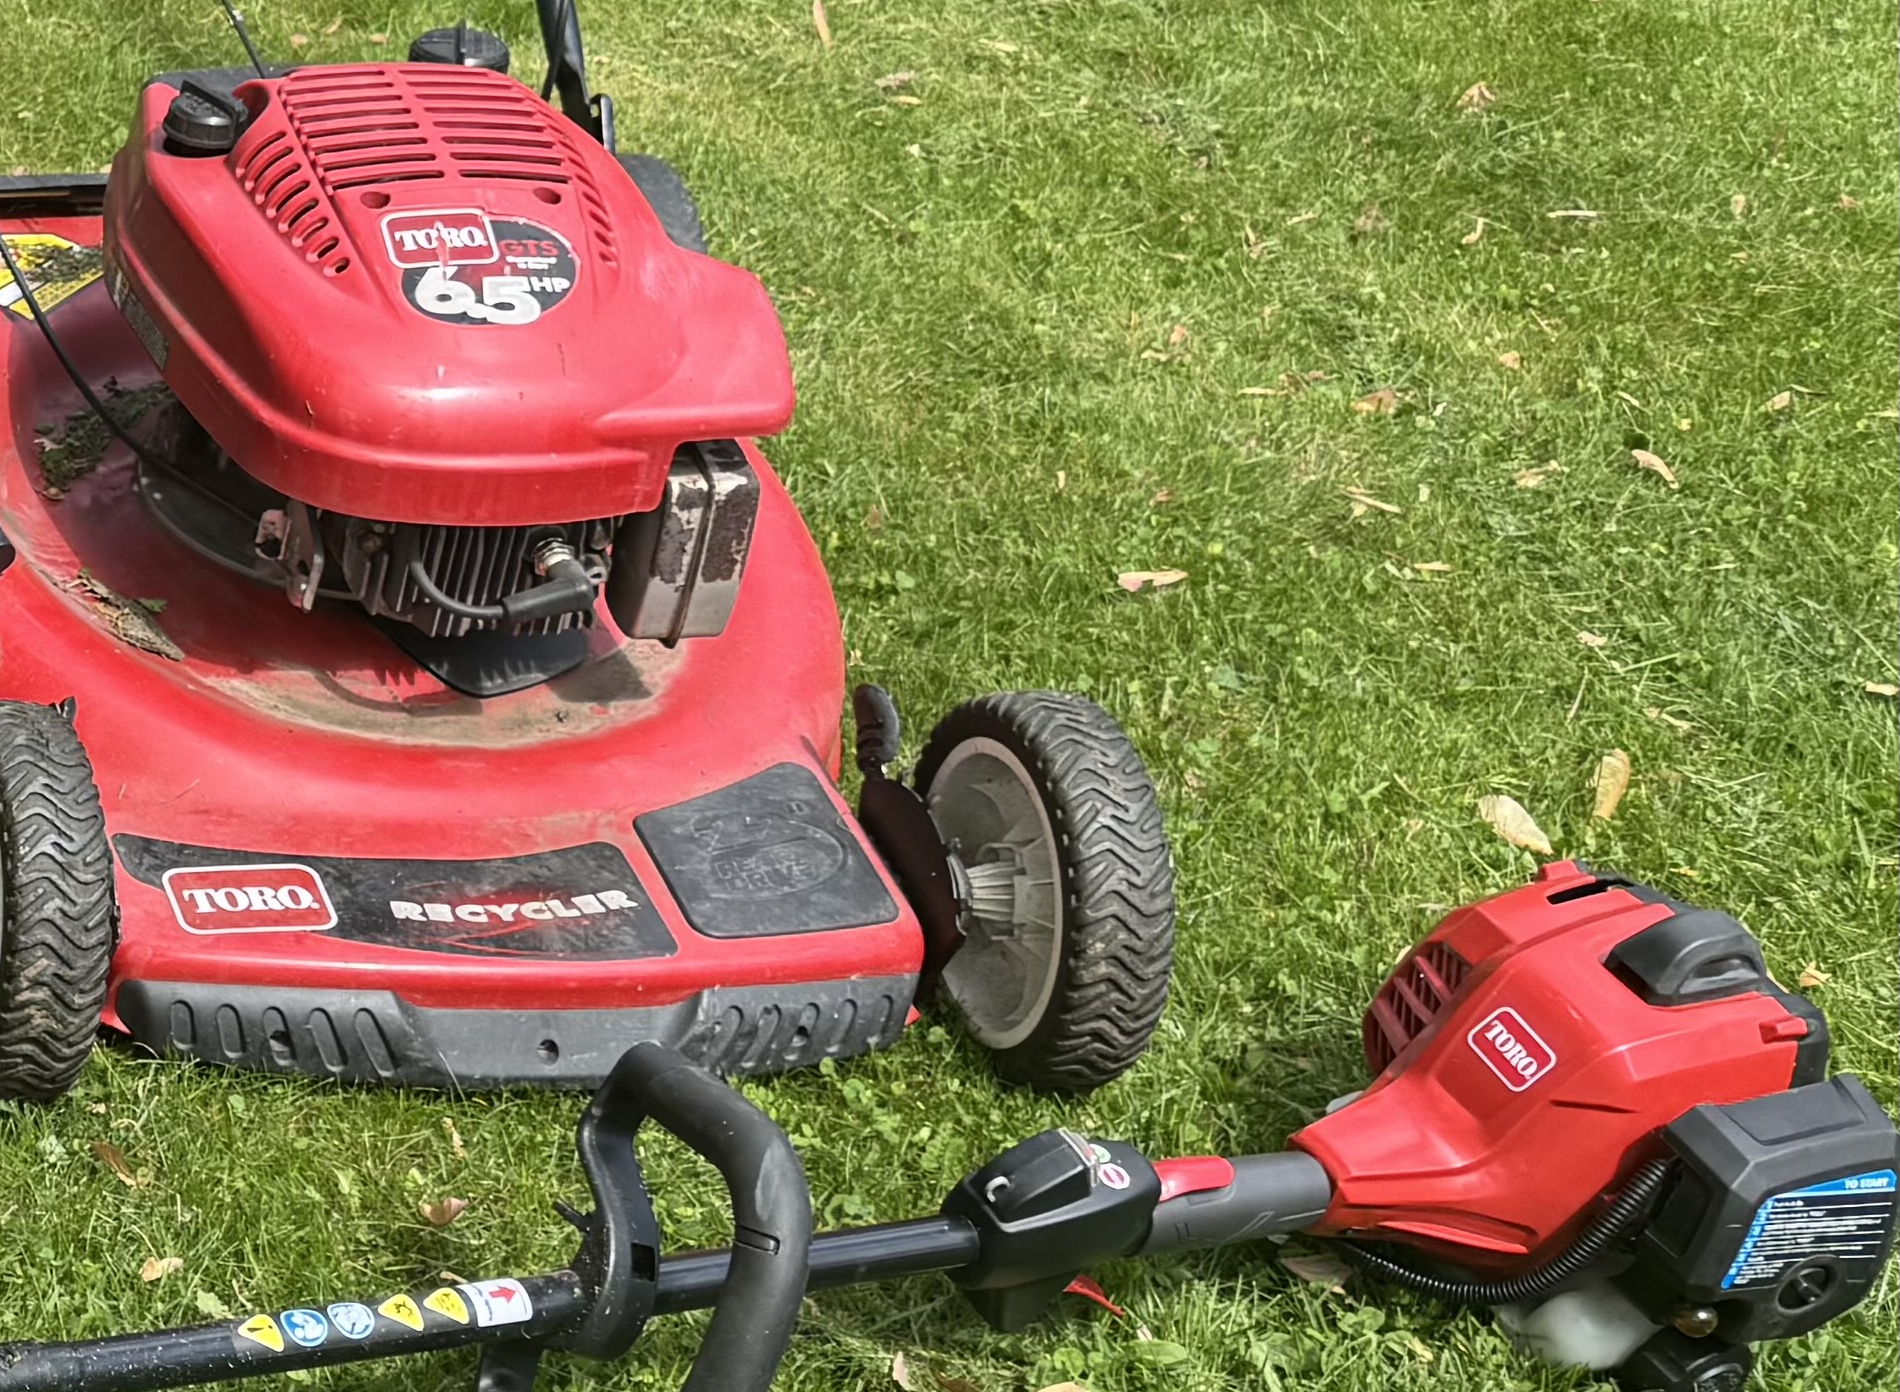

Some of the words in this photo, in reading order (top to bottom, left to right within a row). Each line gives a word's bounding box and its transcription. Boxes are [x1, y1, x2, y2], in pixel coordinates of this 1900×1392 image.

[500, 238, 560, 257] GTS
[529, 276, 571, 293] HP
[389, 889, 639, 923] RECYCLER
[1844, 1179, 1859, 1189] TO
